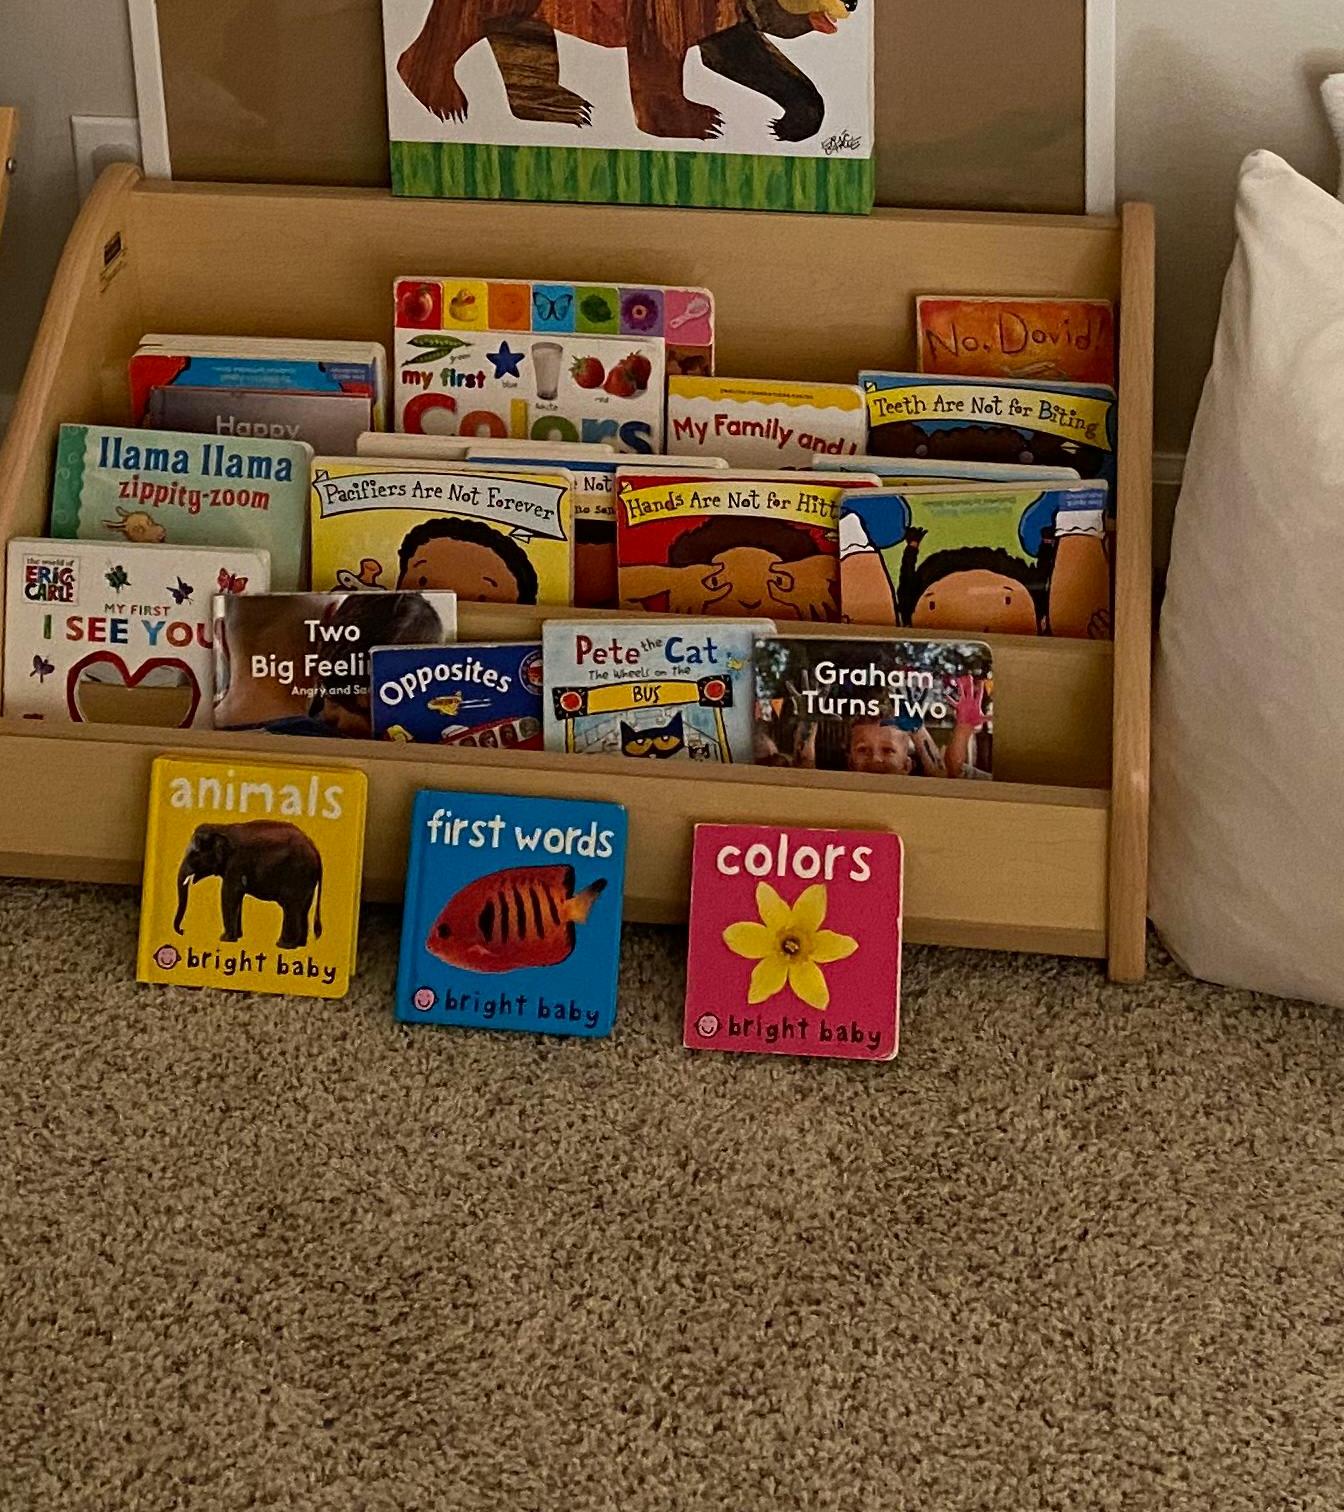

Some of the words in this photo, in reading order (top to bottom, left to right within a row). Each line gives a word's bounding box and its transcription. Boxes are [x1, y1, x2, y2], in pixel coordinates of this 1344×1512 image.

[401, 370, 434, 390] my
[440, 368, 486, 389] first
[216, 415, 301, 438] Happy
[873, 394, 926, 418] Teeth
[932, 394, 965, 413] Are
[971, 395, 1003, 416] Not
[1008, 399, 1033, 417] for
[1038, 400, 1099, 440] Biting
[672, 416, 708, 445] My
[714, 414, 794, 449] Family
[797, 437, 845, 456] and
[98, 436, 190, 475] llama
[200, 443, 293, 483] llama
[118, 474, 272, 515] zippity-zoom
[583, 475, 613, 493] Not
[323, 479, 407, 506] Pacifiers
[411, 481, 443, 499] Are
[447, 484, 480, 507] Not
[486, 487, 555, 521] Forever
[626, 492, 685, 519] Hands
[689, 492, 721, 509] Are
[727, 490, 761, 511] Not
[766, 491, 792, 510] for
[24, 582, 74, 603] CARLE
[105, 603, 126, 615] MY
[130, 604, 172, 617] FIRST
[43, 614, 53, 640] I
[65, 615, 129, 645] SEE
[304, 619, 361, 643] Two
[575, 634, 642, 666] Pete
[640, 638, 664, 653] the
[664, 636, 719, 665] Cat
[251, 655, 294, 685] Big
[379, 656, 513, 707] Opposites
[814, 660, 935, 689] Graham
[291, 685, 327, 699] Angry
[328, 684, 351, 696] and
[632, 685, 662, 704] BUS
[802, 690, 881, 717] Turns
[888, 692, 948, 720] Two
[169, 769, 346, 820] animals
[427, 808, 507, 849] first
[514, 821, 616, 859] words
[716, 832, 874, 883] colors
[186, 947, 267, 976] bright
[276, 953, 338, 985] baby
[445, 988, 528, 1020] bright
[537, 996, 600, 1029] baby
[728, 1013, 809, 1045] bright
[819, 1018, 882, 1051] baby
